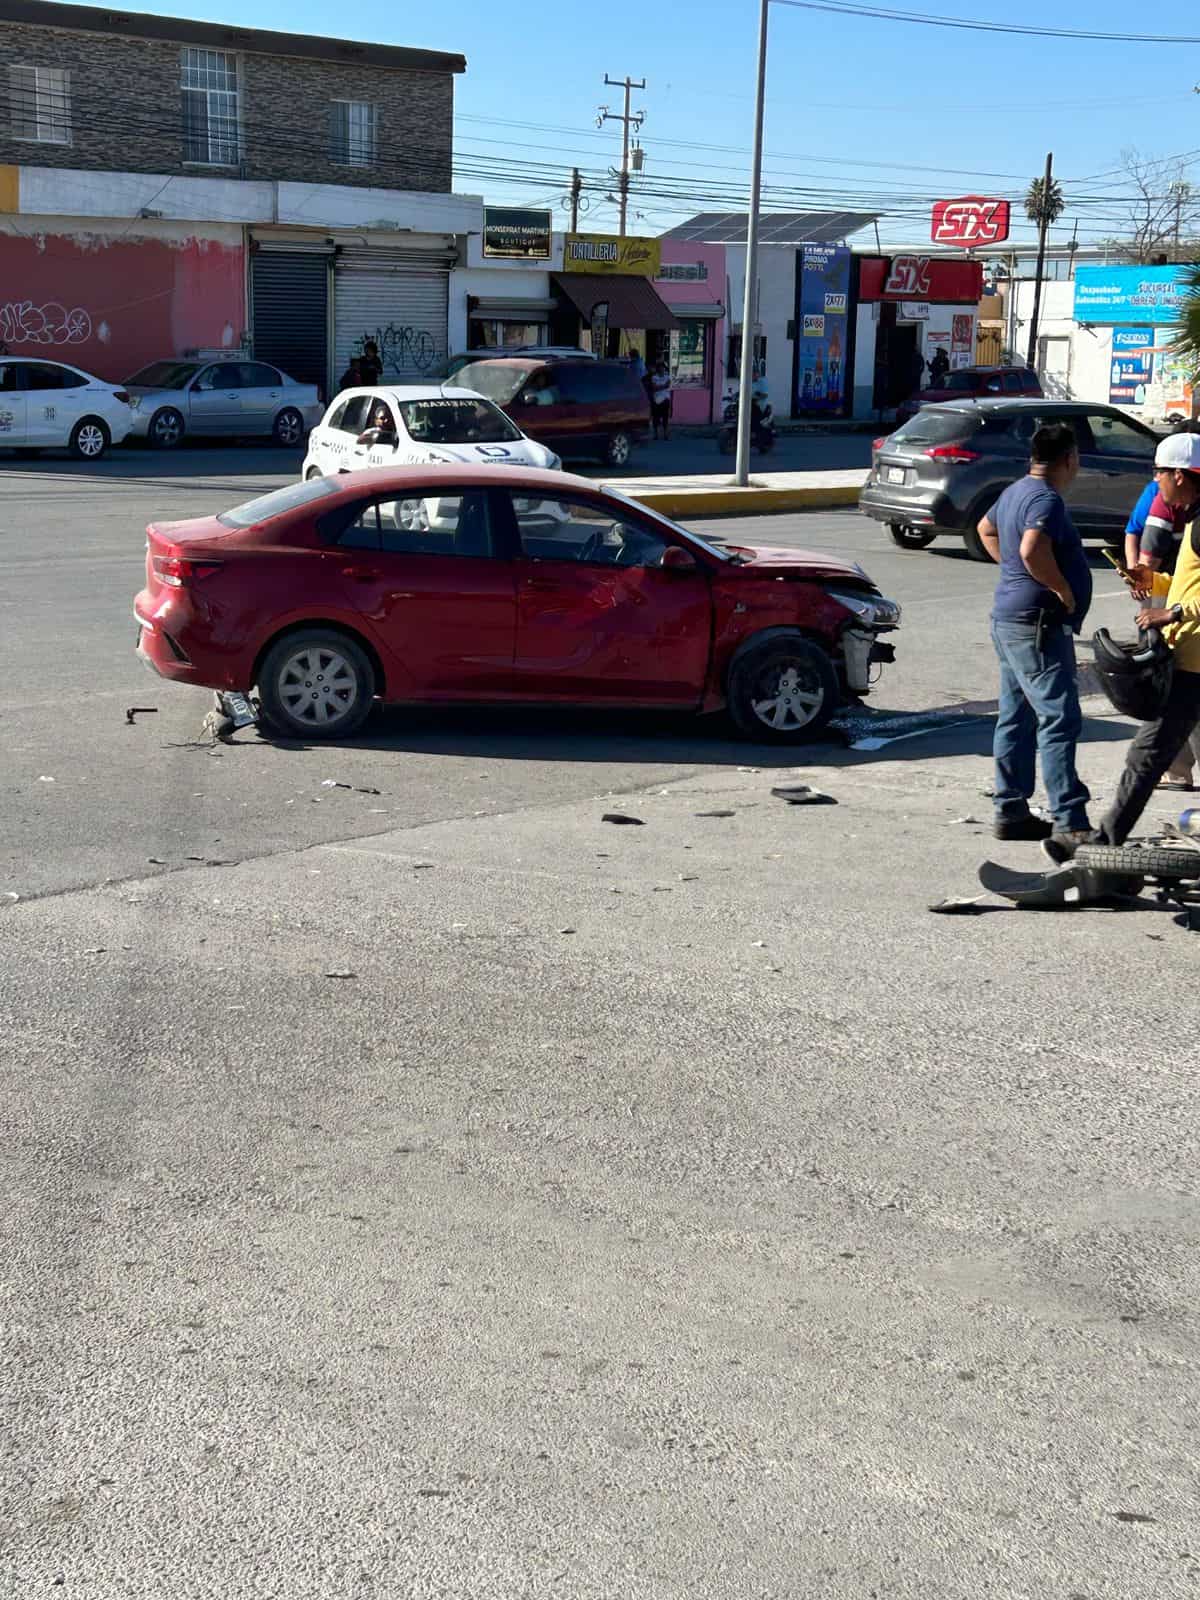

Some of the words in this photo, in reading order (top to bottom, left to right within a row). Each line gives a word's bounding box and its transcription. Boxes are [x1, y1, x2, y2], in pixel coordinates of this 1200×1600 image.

[935, 202, 999, 241] SIX
[568, 241, 617, 260] TORTILLERIA
[884, 256, 932, 294] SIX
